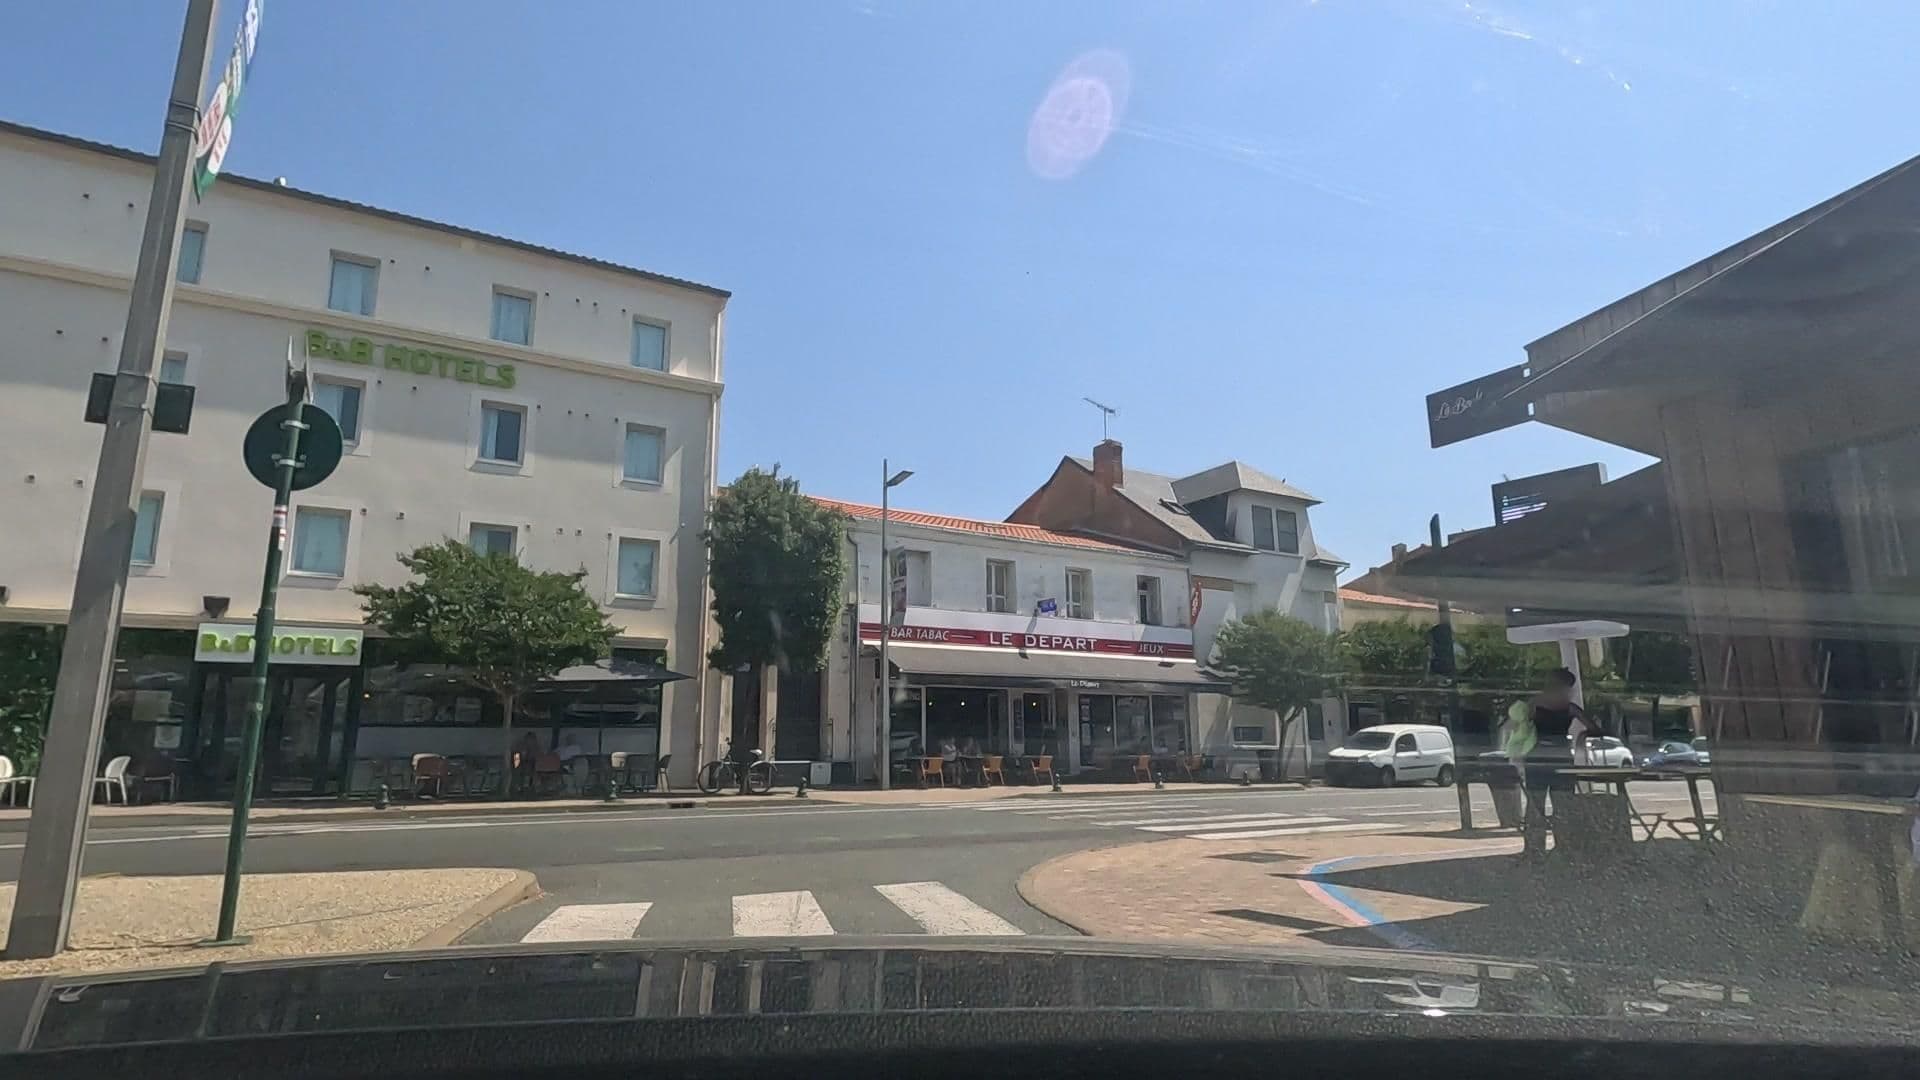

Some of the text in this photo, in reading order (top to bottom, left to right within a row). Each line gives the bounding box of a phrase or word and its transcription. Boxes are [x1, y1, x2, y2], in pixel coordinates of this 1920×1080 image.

[384, 343, 517, 389] HOTELS
[890, 627, 950, 640] BAR TABAC
[990, 632, 1098, 650] LE DEPART
[1138, 643, 1164, 654] JEUX
